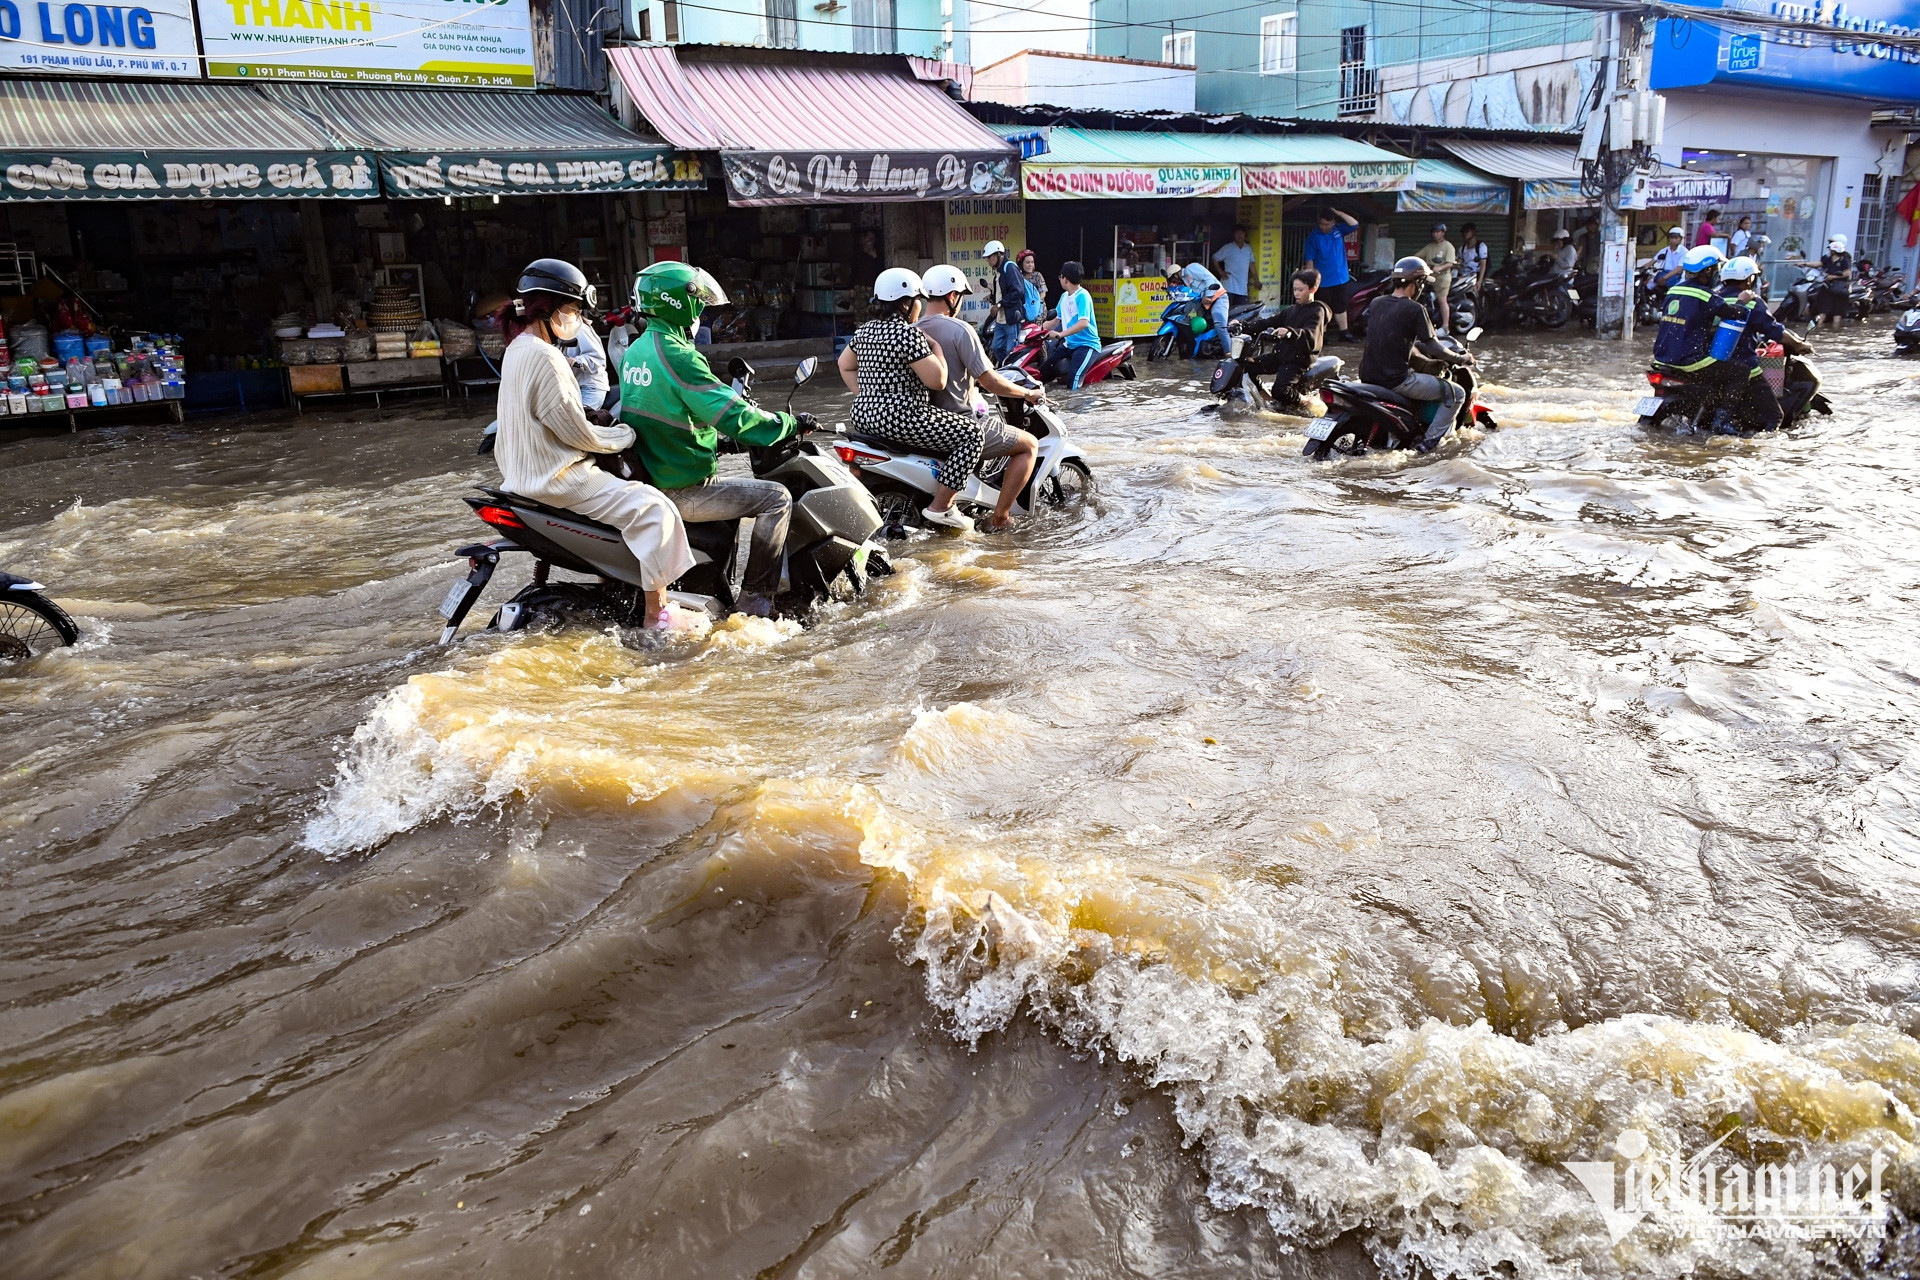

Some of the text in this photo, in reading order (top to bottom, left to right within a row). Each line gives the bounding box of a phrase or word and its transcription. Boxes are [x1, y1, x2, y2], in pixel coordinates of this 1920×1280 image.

[38, 2, 156, 49] LONG
[1732, 46, 1758, 59] true
[20, 55, 38, 64] 191
[41, 55, 69, 67] PHẠM
[118, 60, 127, 69] P.
[130, 59, 148, 70] PHÚ
[171, 62, 180, 71] Q.
[1731, 57, 1756, 69] mart
[256, 68, 274, 77] 191
[278, 69, 306, 80] Phạm
[331, 70, 348, 79] Lầu
[357, 71, 392, 82] Phường
[395, 72, 411, 81] Phú
[415, 73, 428, 84] Mỹ
[437, 75, 461, 85] Quận
[464, 76, 469, 84] 7
[477, 76, 490, 86] Tp.
[493, 77, 512, 85] HCM
[93, 163, 161, 190] GIA
[163, 163, 262, 195] DỤNG
[267, 157, 327, 190] GIÁ
[330, 155, 373, 190] RẺ
[390, 155, 445, 190] THẾ
[507, 162, 555, 186] GIA
[556, 160, 625, 190] DỤNG
[628, 154, 669, 183] GIÁ
[767, 153, 967, 200] Cà Phê Mang Đi
[1026, 169, 1067, 193] CHÁO
[1069, 173, 1104, 192] DINH
[1106, 169, 1155, 193] DƯỠNG
[1158, 168, 1200, 183] QUANG
[1203, 168, 1231, 181] MINH
[1245, 168, 1278, 190] CHÁO
[1280, 171, 1307, 189] DINH
[1308, 166, 1346, 188] DƯỠNG
[1350, 164, 1383, 178] QUANG
[1386, 163, 1409, 175] MINH
[1657, 186, 1672, 198] TÓC
[1704, 181, 1729, 196] SANG
[973, 200, 992, 215] DINH
[969, 225, 989, 244] TRỰC
[1139, 280, 1160, 292] CHÁO
[660, 291, 682, 310] Grab
[1150, 293, 1164, 302] NẤU
[623, 361, 652, 386] Grab
[545, 520, 601, 541] VARIO
